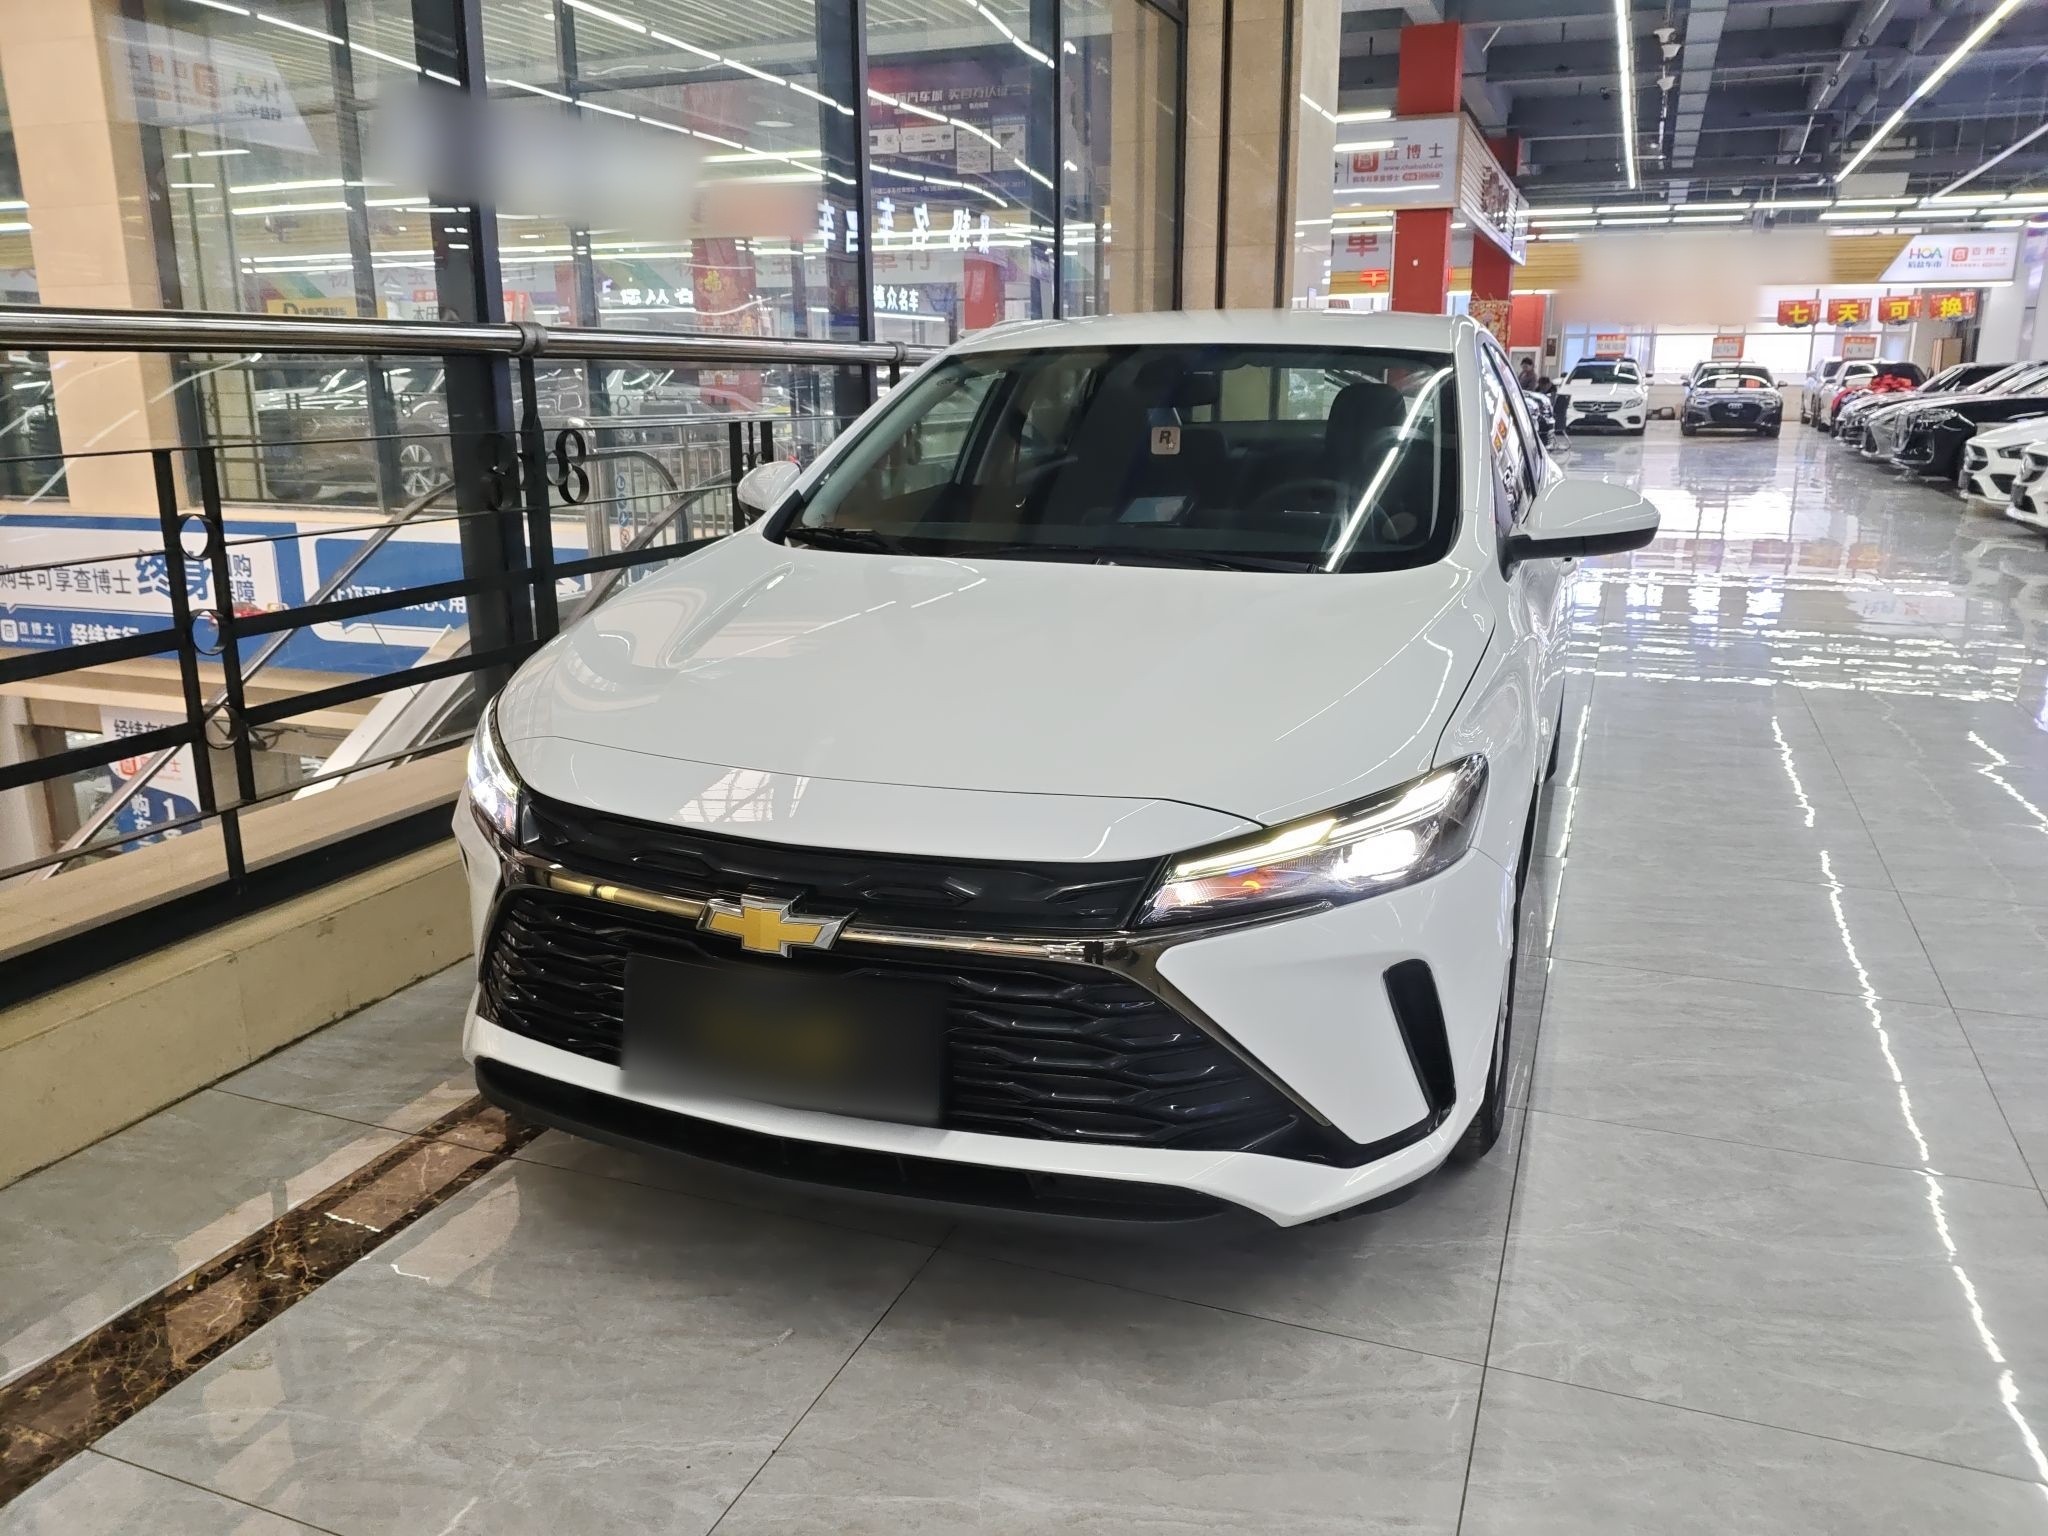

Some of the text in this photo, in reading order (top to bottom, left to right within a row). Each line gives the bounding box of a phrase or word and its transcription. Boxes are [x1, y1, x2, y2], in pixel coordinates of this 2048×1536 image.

[1788, 297, 1963, 324] 七 天 可 换
[1159, 430, 1171, 444] R
